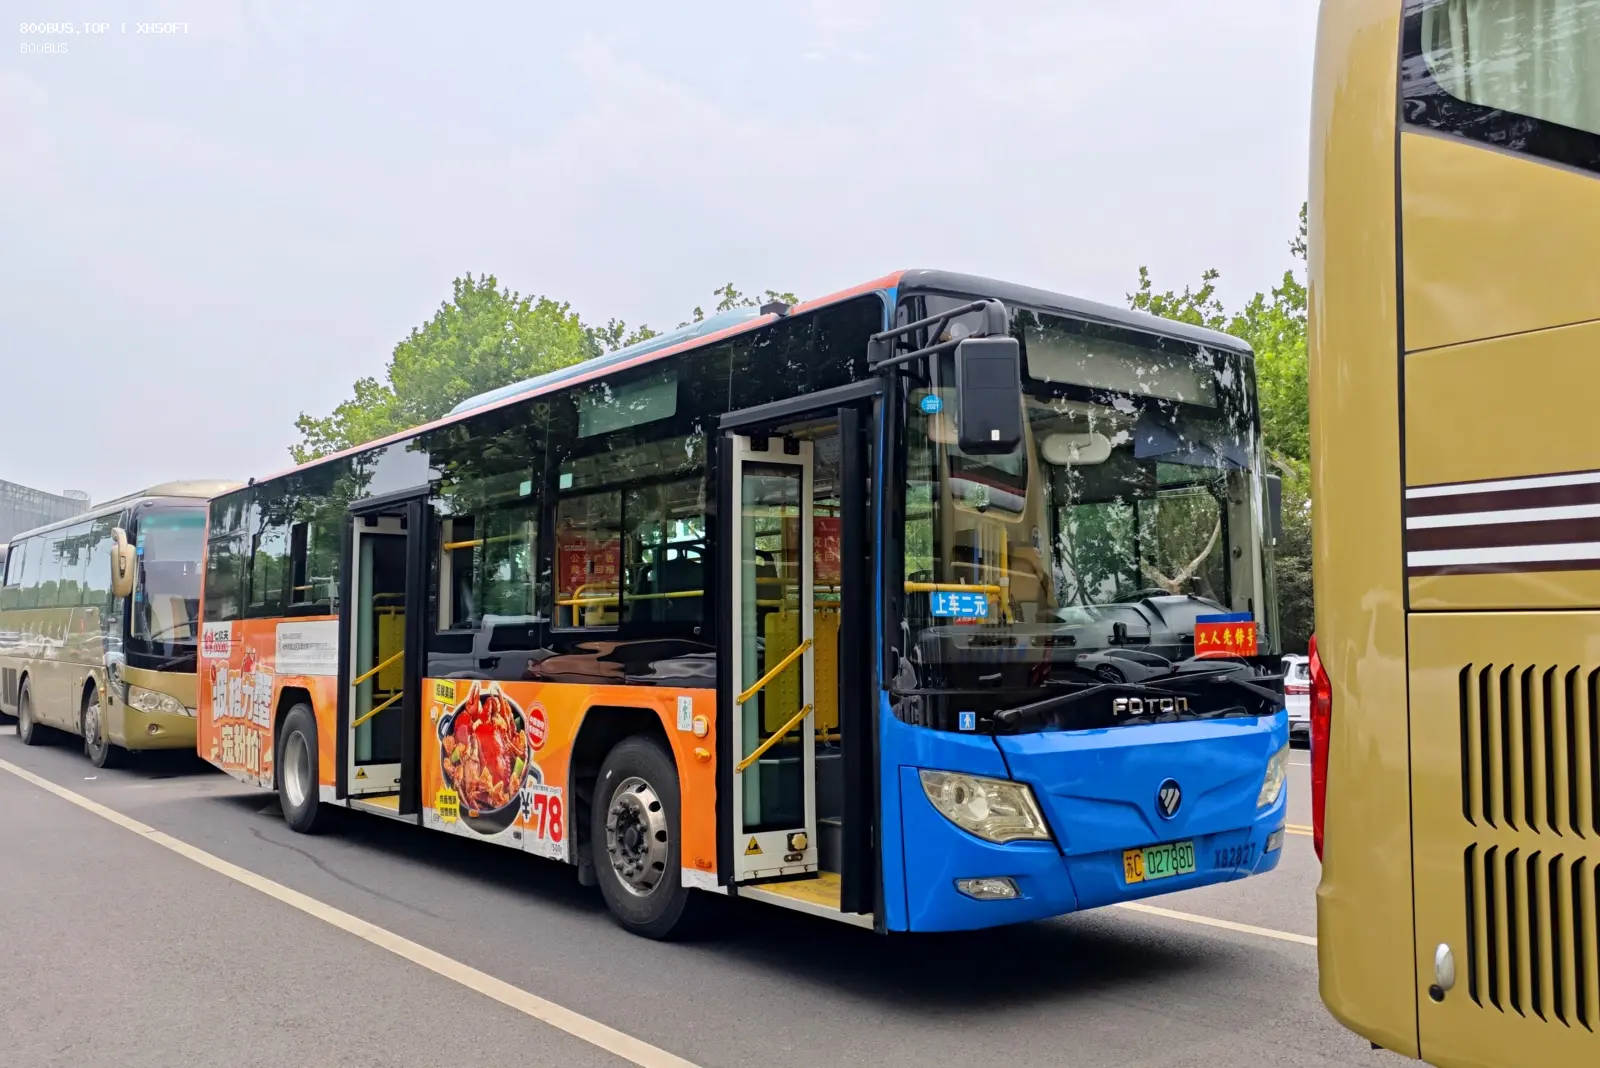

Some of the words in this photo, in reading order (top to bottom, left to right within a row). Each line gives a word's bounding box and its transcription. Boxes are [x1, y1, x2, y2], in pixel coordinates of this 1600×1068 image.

[935, 593, 986, 616] 上车二元
[1198, 627, 1254, 648] 工人先锋号
[1112, 696, 1188, 716] FOTON
